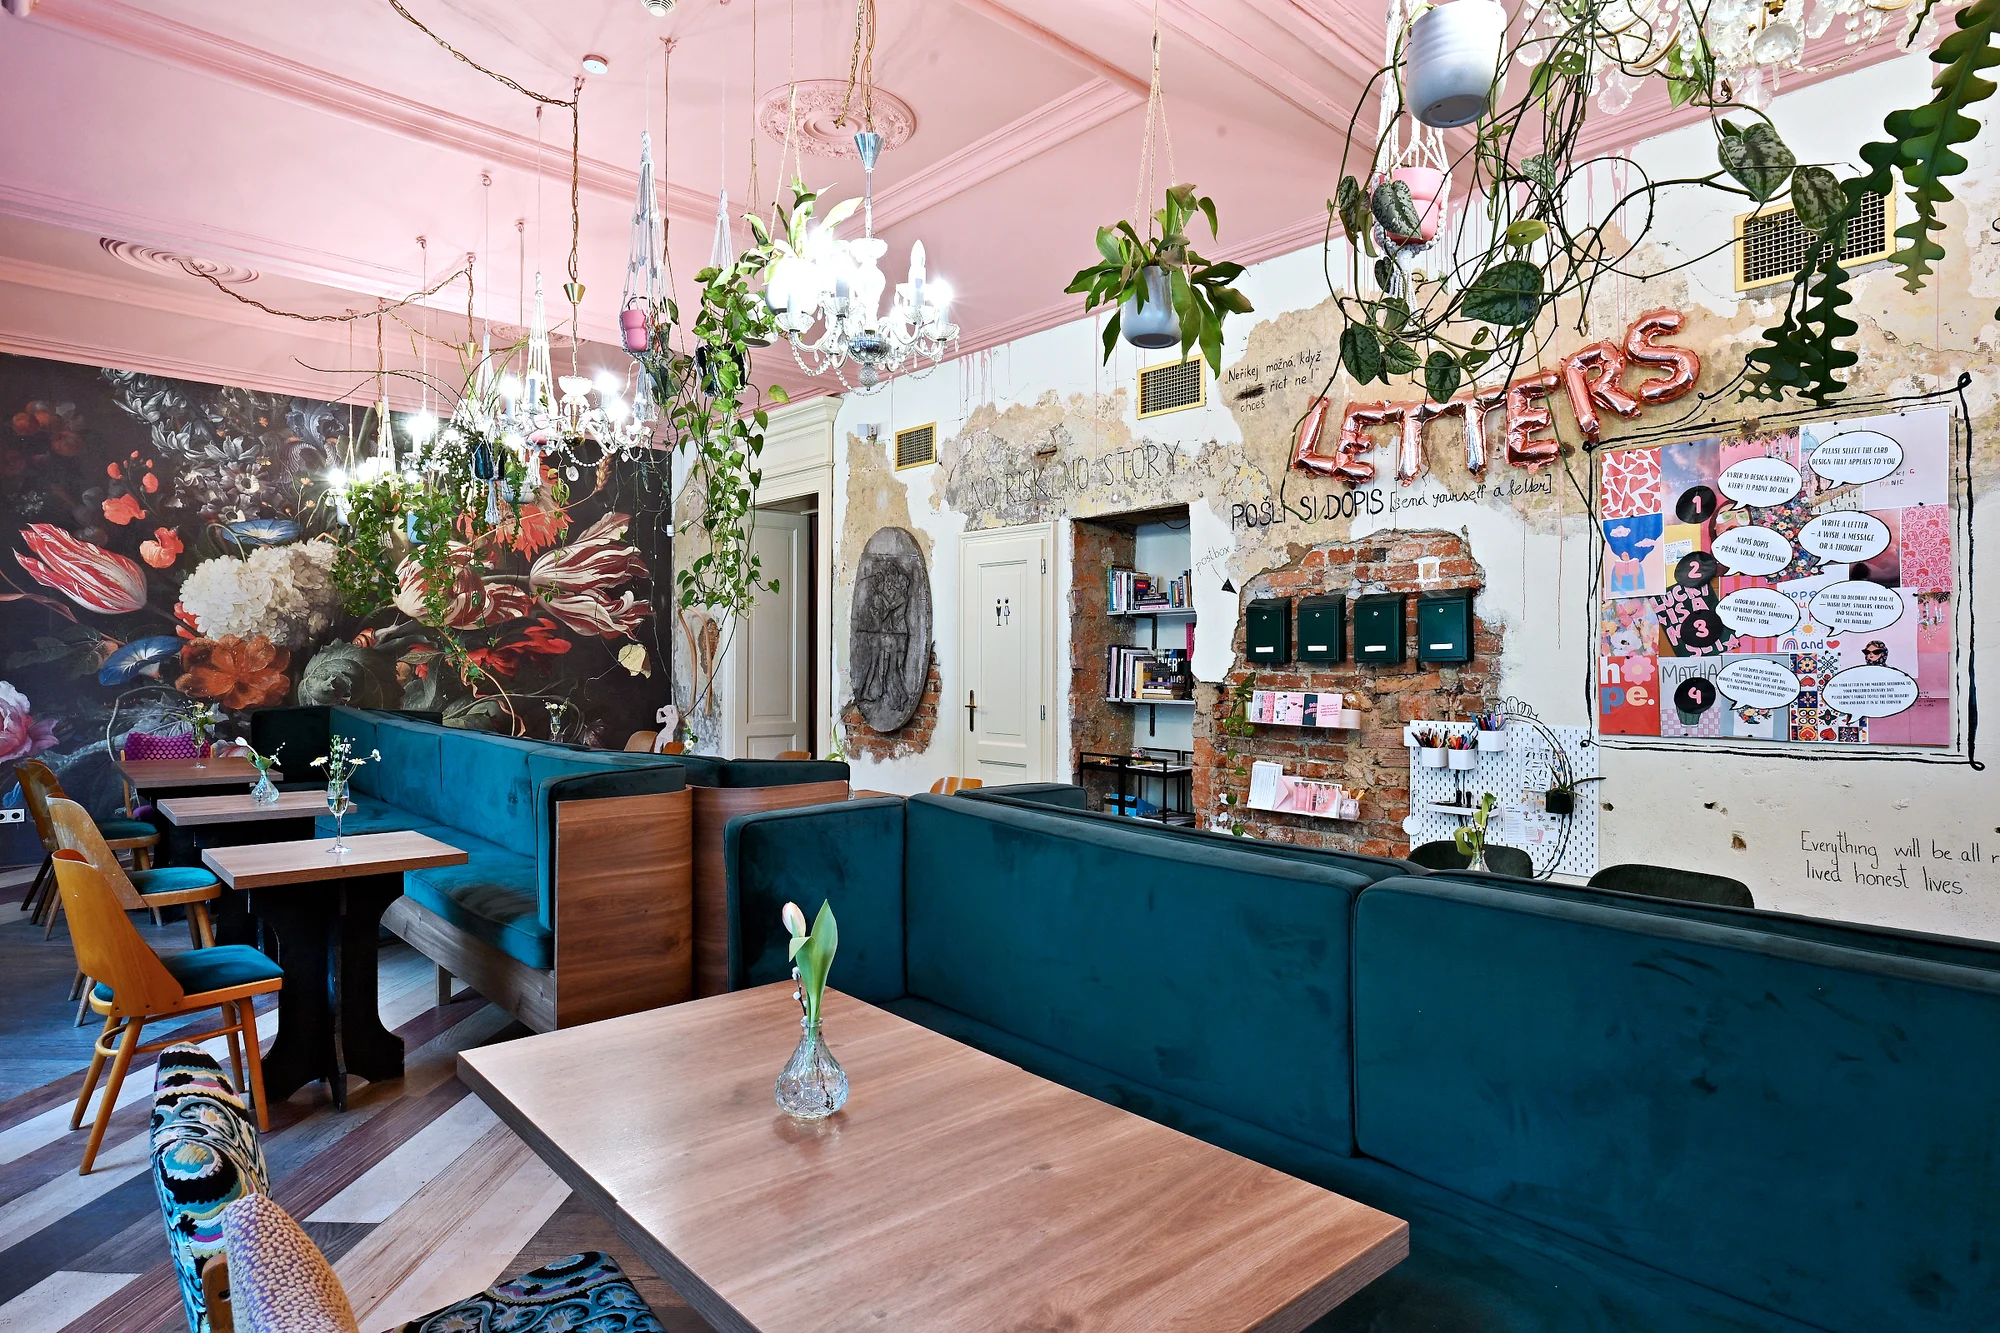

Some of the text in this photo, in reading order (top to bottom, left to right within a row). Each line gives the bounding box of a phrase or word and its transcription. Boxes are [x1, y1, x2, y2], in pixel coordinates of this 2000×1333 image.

[1299, 349, 1323, 369] když
[1240, 398, 1266, 413] chceš
[1293, 306, 1701, 488] LETTERS
[1062, 457, 1090, 490] NO
[1103, 440, 1181, 486] STORY
[1432, 484, 1487, 508] yourself
[1492, 486, 1504, 497] a
[1692, 495, 1702, 514] 1
[1231, 496, 1287, 531] POŠLI
[1325, 488, 1385, 521] DOPIS
[1822, 519, 1840, 527] WRITE
[1848, 521, 1868, 529] LETTER
[1753, 540, 1769, 548] DOPIS
[1196, 546, 1230, 576] postbox
[1688, 560, 1702, 579] 2
[1693, 619, 1709, 638] 3
[1801, 639, 1824, 650] and
[1662, 661, 1718, 685] MATCHA
[1688, 687, 1702, 704] 4
[1801, 830, 1879, 869] Everything
[1894, 838, 1920, 859] will
[1932, 838, 1953, 861] be
[1961, 842, 1981, 863] all
[1806, 859, 1842, 882] lived
[1853, 863, 1909, 889] honest
